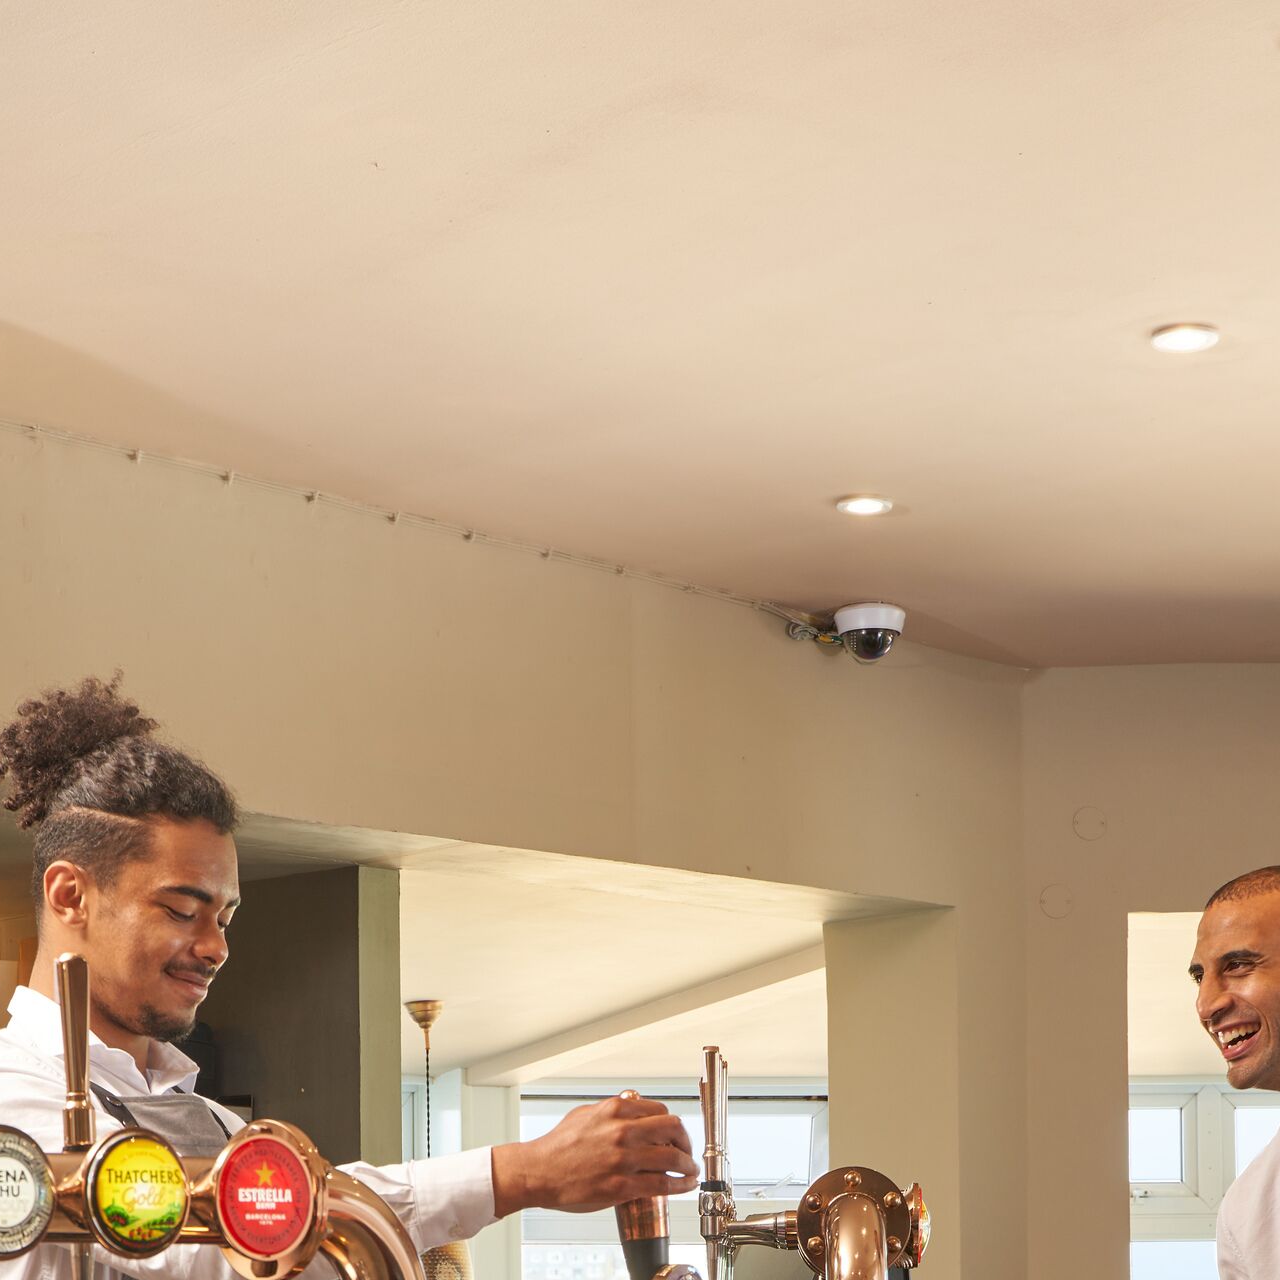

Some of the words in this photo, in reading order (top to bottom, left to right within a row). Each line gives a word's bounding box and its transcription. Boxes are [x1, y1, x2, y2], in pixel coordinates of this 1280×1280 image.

[107, 1168, 182, 1185] THATCHERS
[122, 1186, 168, 1213] Gold
[238, 1188, 293, 1203] ESTRELLA
